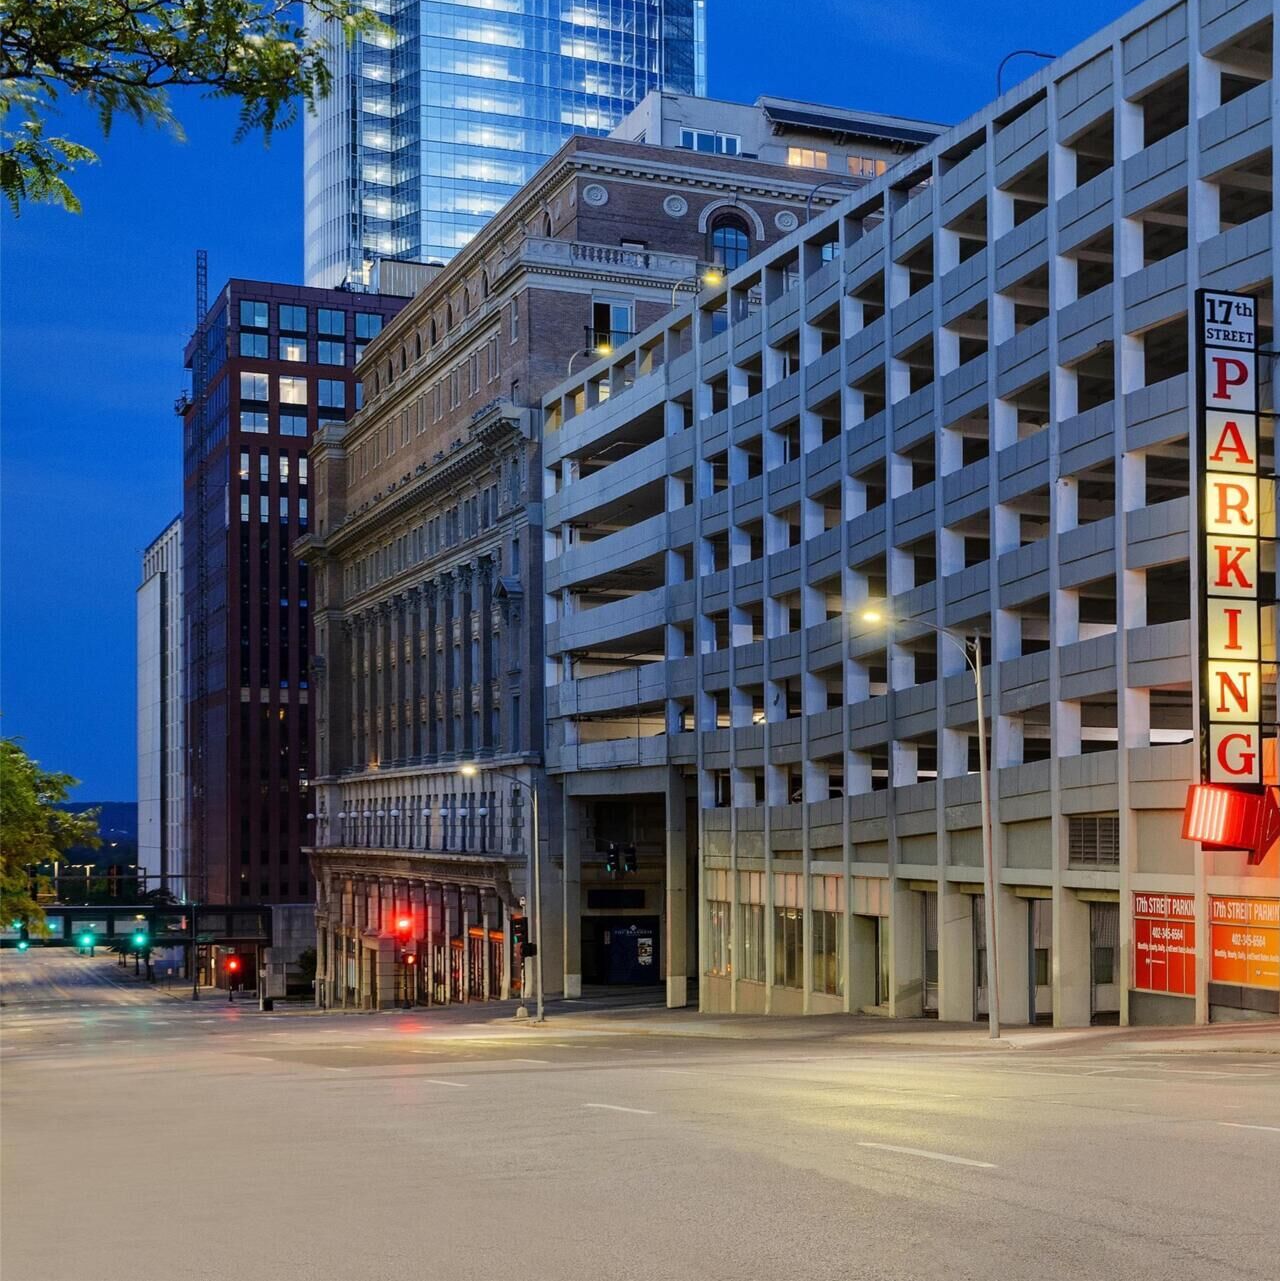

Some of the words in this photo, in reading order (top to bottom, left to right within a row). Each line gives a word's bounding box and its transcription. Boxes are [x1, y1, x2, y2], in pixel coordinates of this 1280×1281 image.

[1206, 298, 1253, 326] 17th
[1206, 327, 1254, 344] STREET
[1209, 356, 1255, 776] PARKING
[1136, 897, 1148, 913] 17th
[1148, 897, 1171, 915] STREET
[1213, 902, 1227, 918] 17th
[1227, 902, 1253, 920] STREET
